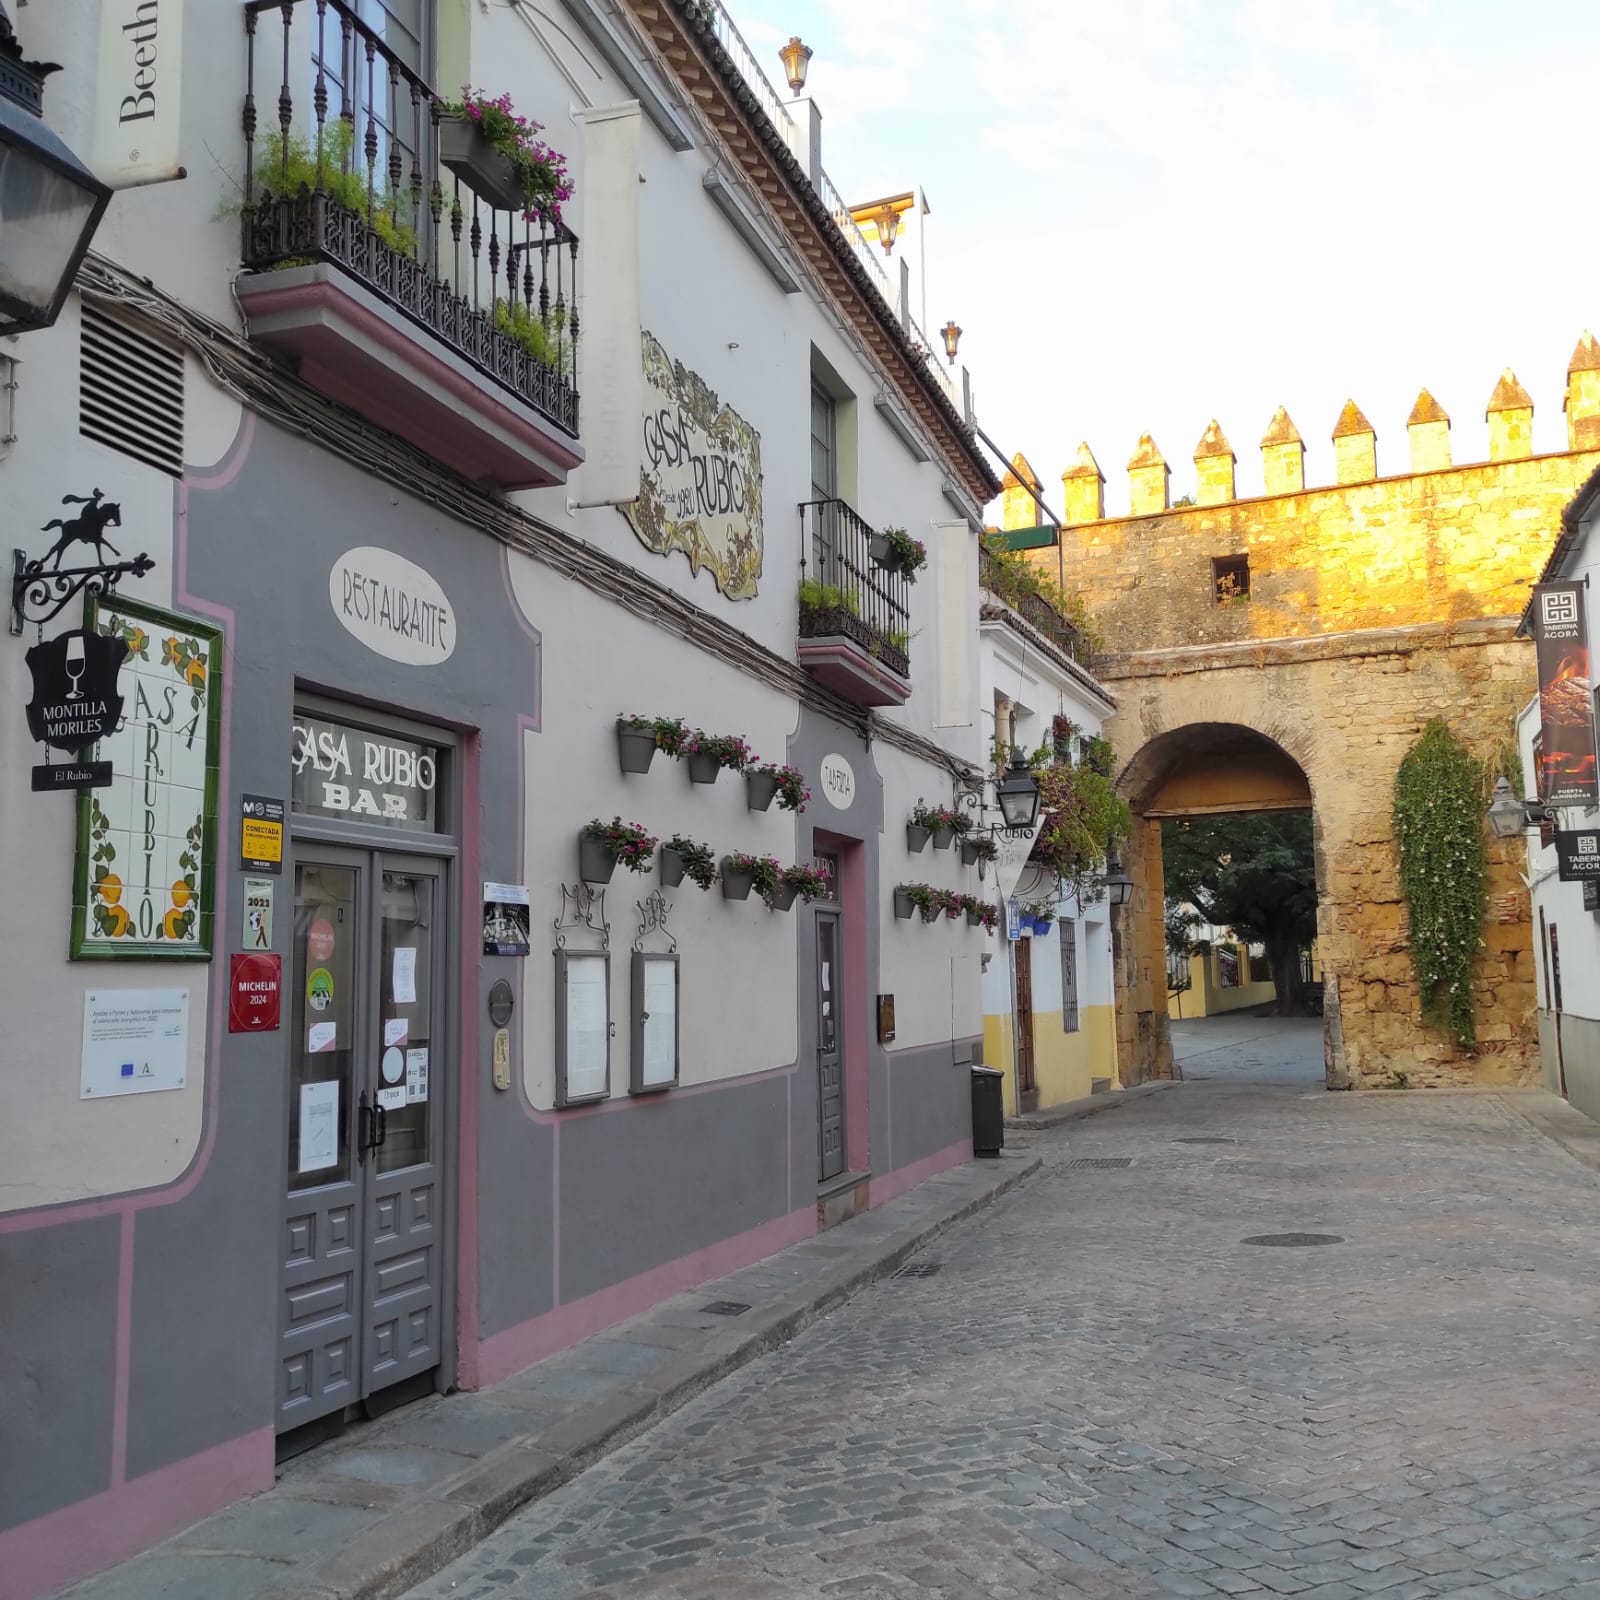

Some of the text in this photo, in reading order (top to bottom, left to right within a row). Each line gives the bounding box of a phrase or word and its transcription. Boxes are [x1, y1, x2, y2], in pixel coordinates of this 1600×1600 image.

[643, 404, 693, 470] CASA
[343, 567, 447, 651] RESTAURANTE
[1543, 623, 1578, 631] TABERNA
[42, 700, 107, 720] MONTILLA
[47, 718, 102, 737] MORILES
[291, 726, 352, 781] CASA
[55, 769, 93, 781] El Rubio
[322, 782, 407, 820] BAR
[238, 981, 277, 991] MICHELIN
[250, 995, 267, 1005] 2024
